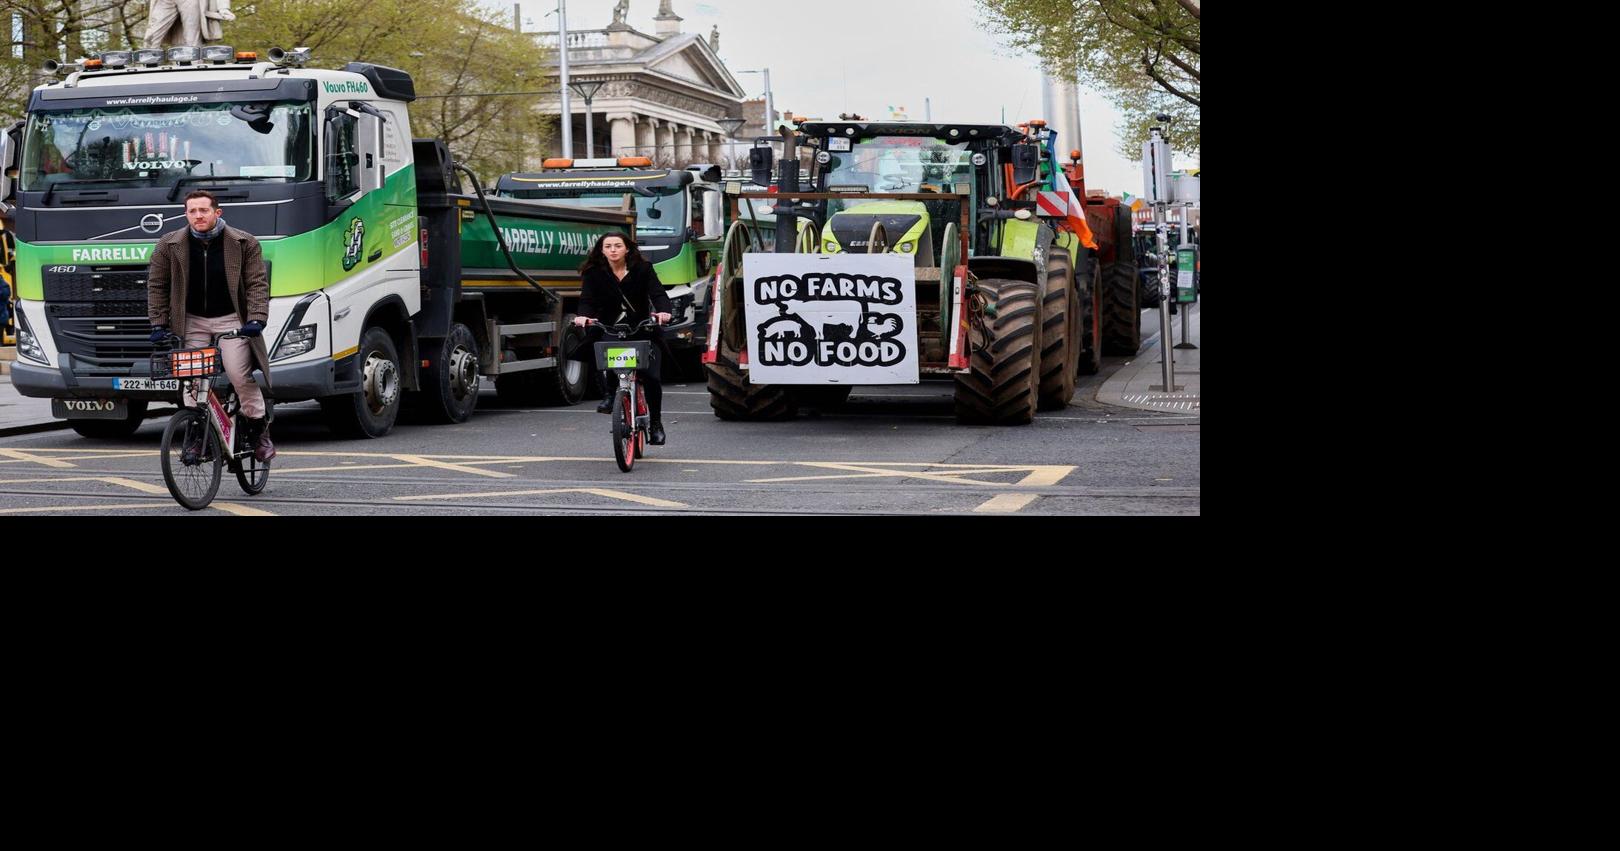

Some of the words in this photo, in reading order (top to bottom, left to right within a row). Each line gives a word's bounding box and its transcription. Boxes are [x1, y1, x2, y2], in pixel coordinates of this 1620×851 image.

[323, 81, 345, 93] Volvo
[346, 81, 368, 93] FH460
[106, 95, 198, 105] www.farrellyhaulage.ie
[127, 160, 186, 170] VOLVO
[537, 180, 635, 188] www.farrellyhaulage.ie
[559, 231, 602, 256] HAULA
[72, 247, 148, 262] FARRELLY
[48, 265, 77, 273] 460
[760, 279, 798, 301] NO
[807, 277, 897, 301] FARMS
[764, 341, 808, 362] NO
[820, 341, 900, 363] FOOD
[123, 379, 178, 390] 222-MH-646
[63, 400, 115, 411] VOLVO
